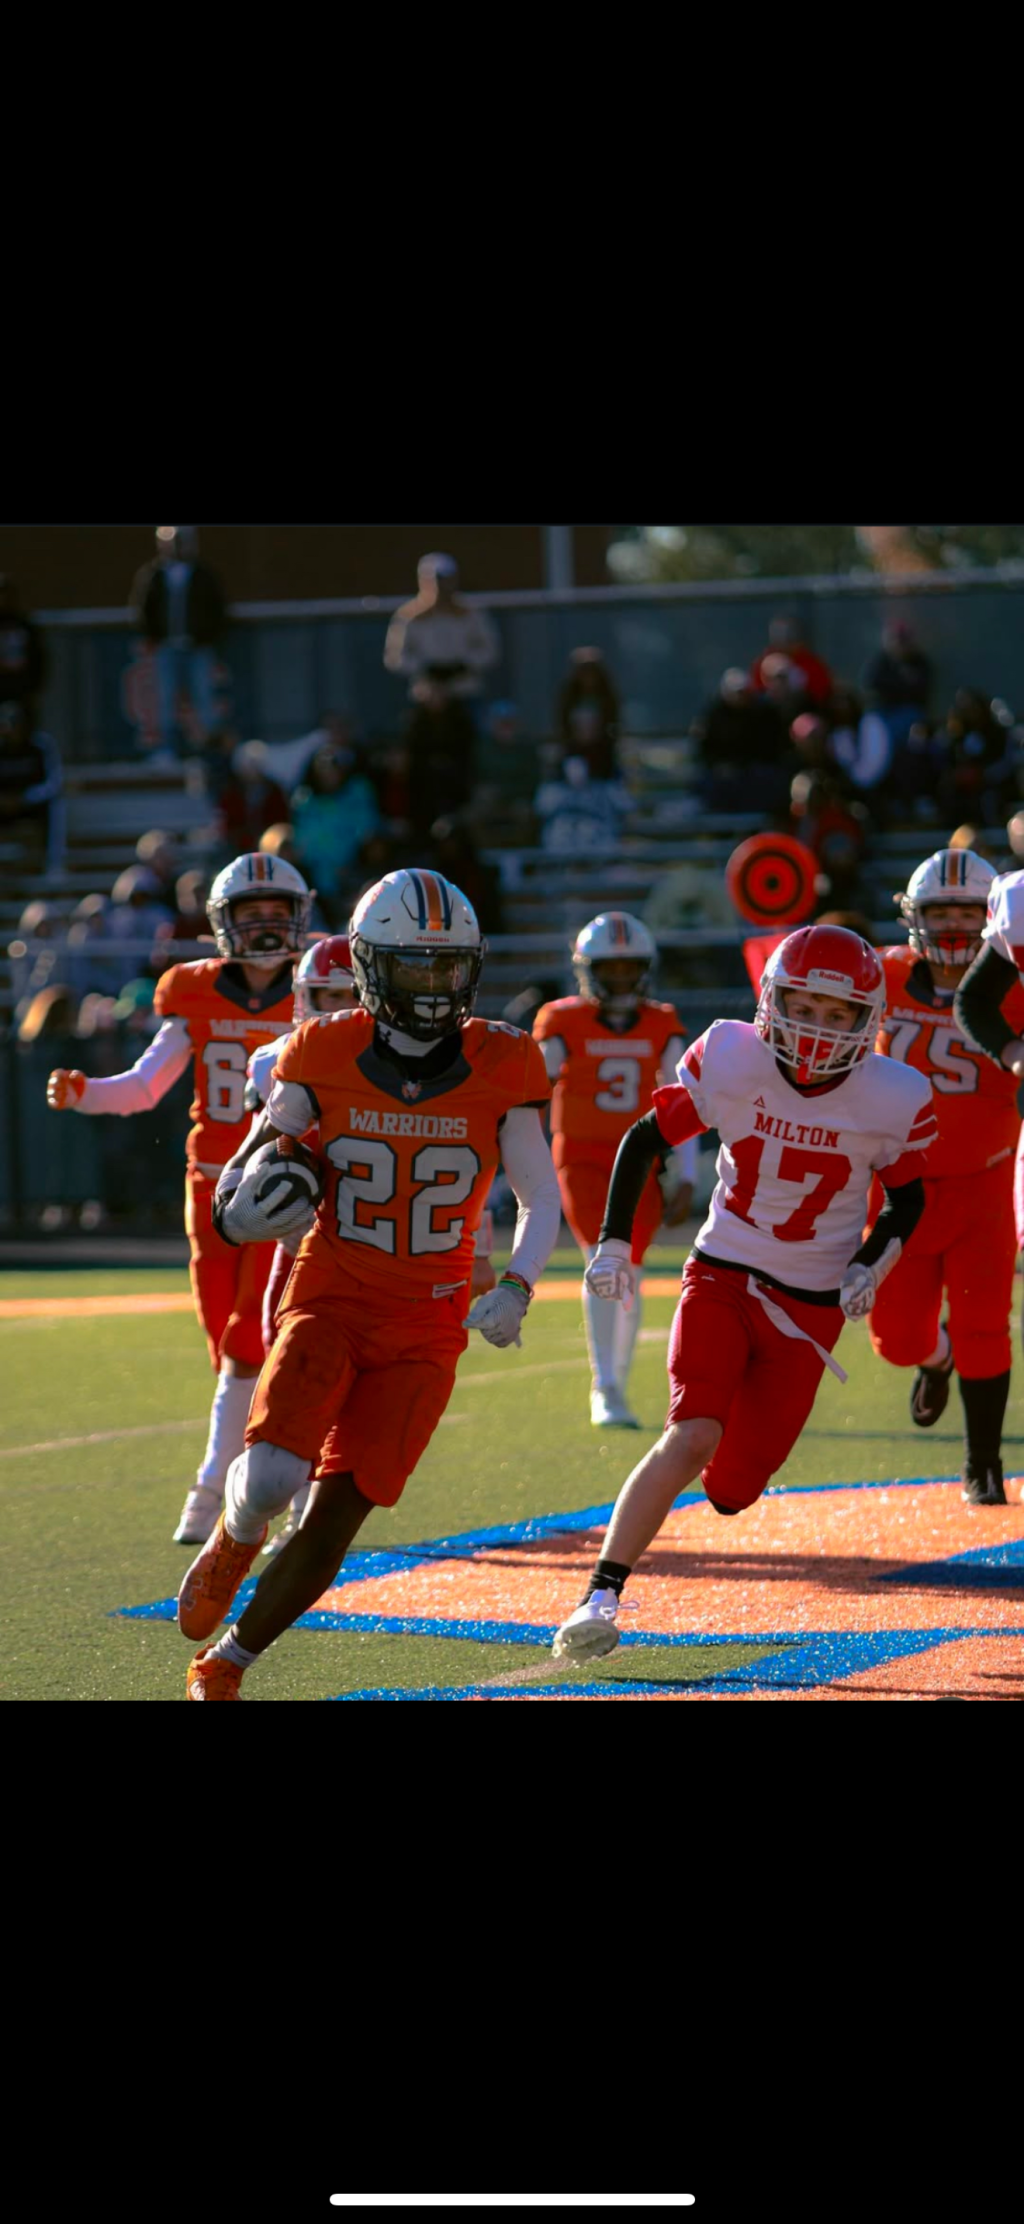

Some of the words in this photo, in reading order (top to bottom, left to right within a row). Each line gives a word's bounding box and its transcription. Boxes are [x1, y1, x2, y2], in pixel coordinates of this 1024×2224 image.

[595, 1057, 641, 1113] 3
[884, 1018, 983, 1094] 75
[350, 1108, 468, 1139] WARRIORS
[754, 1111, 841, 1149] MILTON
[325, 1134, 482, 1256] 22
[724, 1134, 853, 1243] 17
